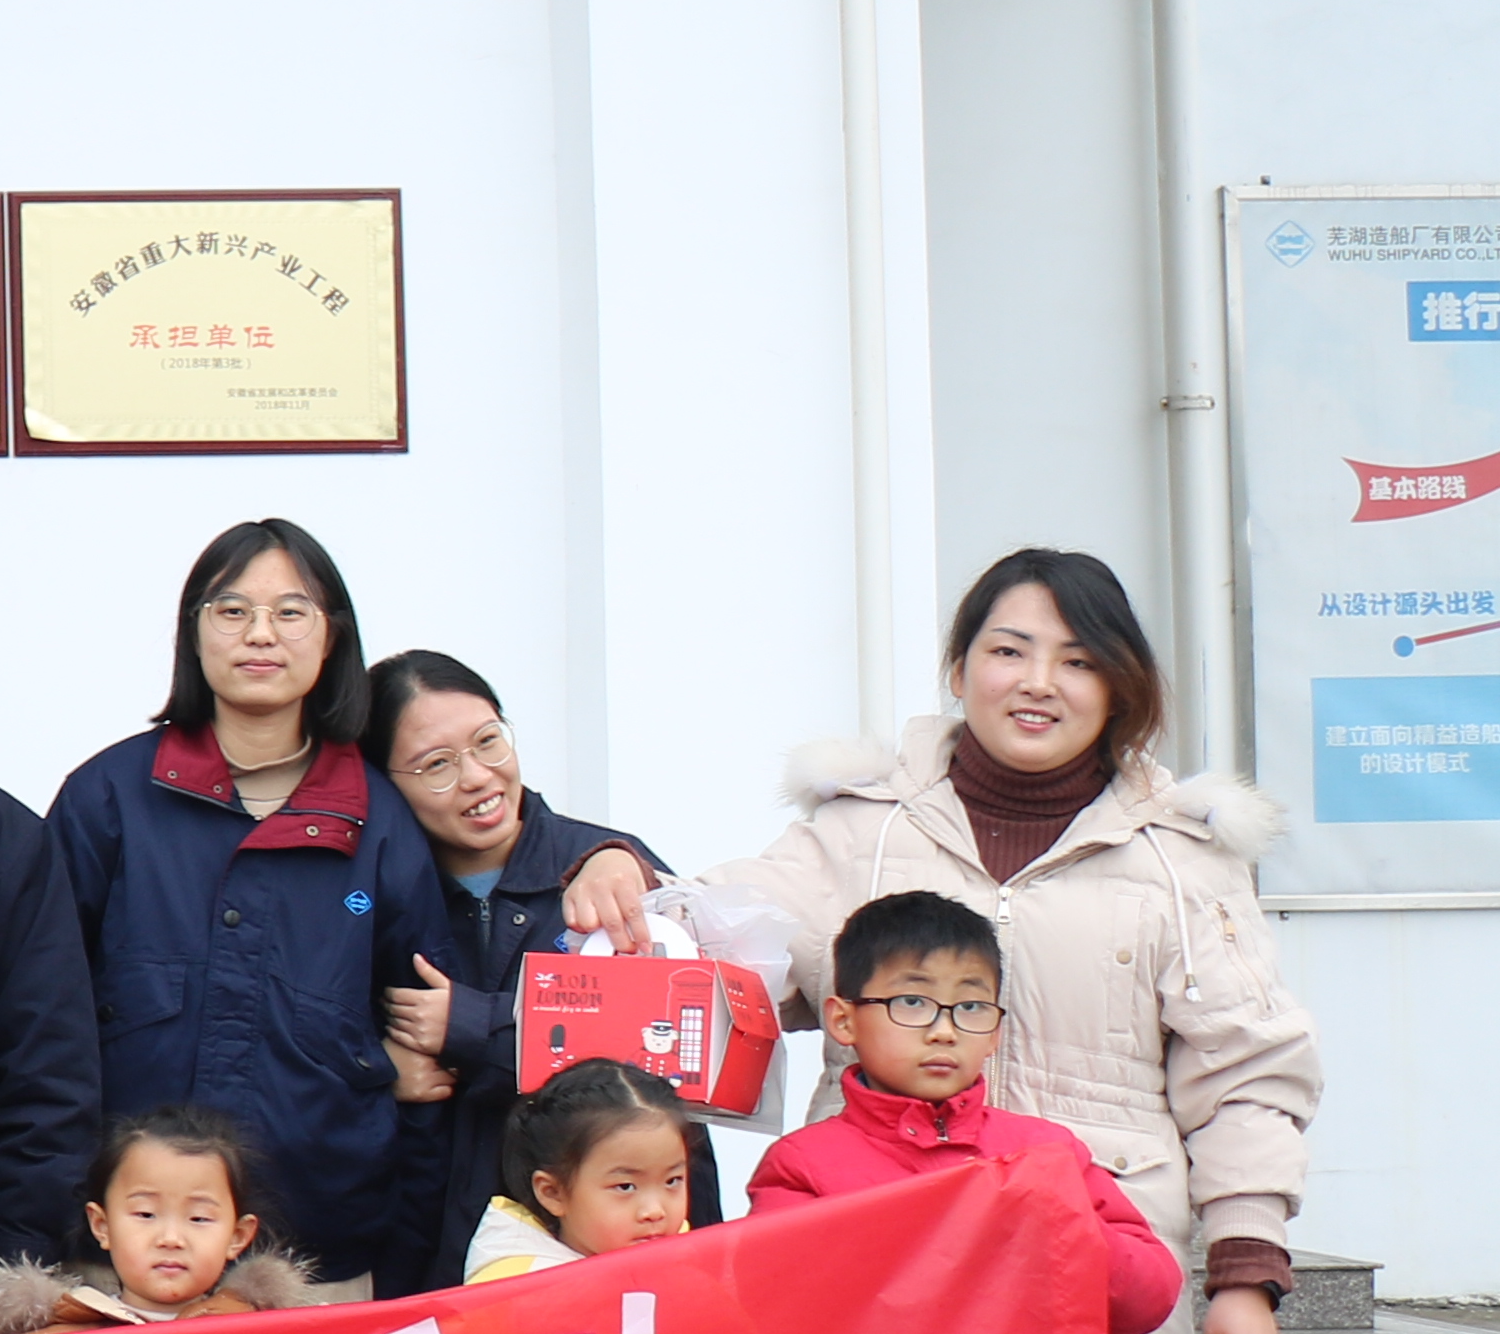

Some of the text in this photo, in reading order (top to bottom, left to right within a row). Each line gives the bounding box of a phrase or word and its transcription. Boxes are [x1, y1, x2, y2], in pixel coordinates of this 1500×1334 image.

[1328, 249, 1373, 261] WUHU
[1377, 248, 1451, 260] SHIPYARD
[69, 231, 349, 317] 安徽省重大新兴产业工程
[1422, 291, 1500, 331] 推行
[129, 324, 276, 349] 承担单位
[1368, 475, 1467, 500] 基本路线
[1318, 590, 1496, 616] 从设计源头出发
[1360, 752, 1470, 774] 的设计模式
